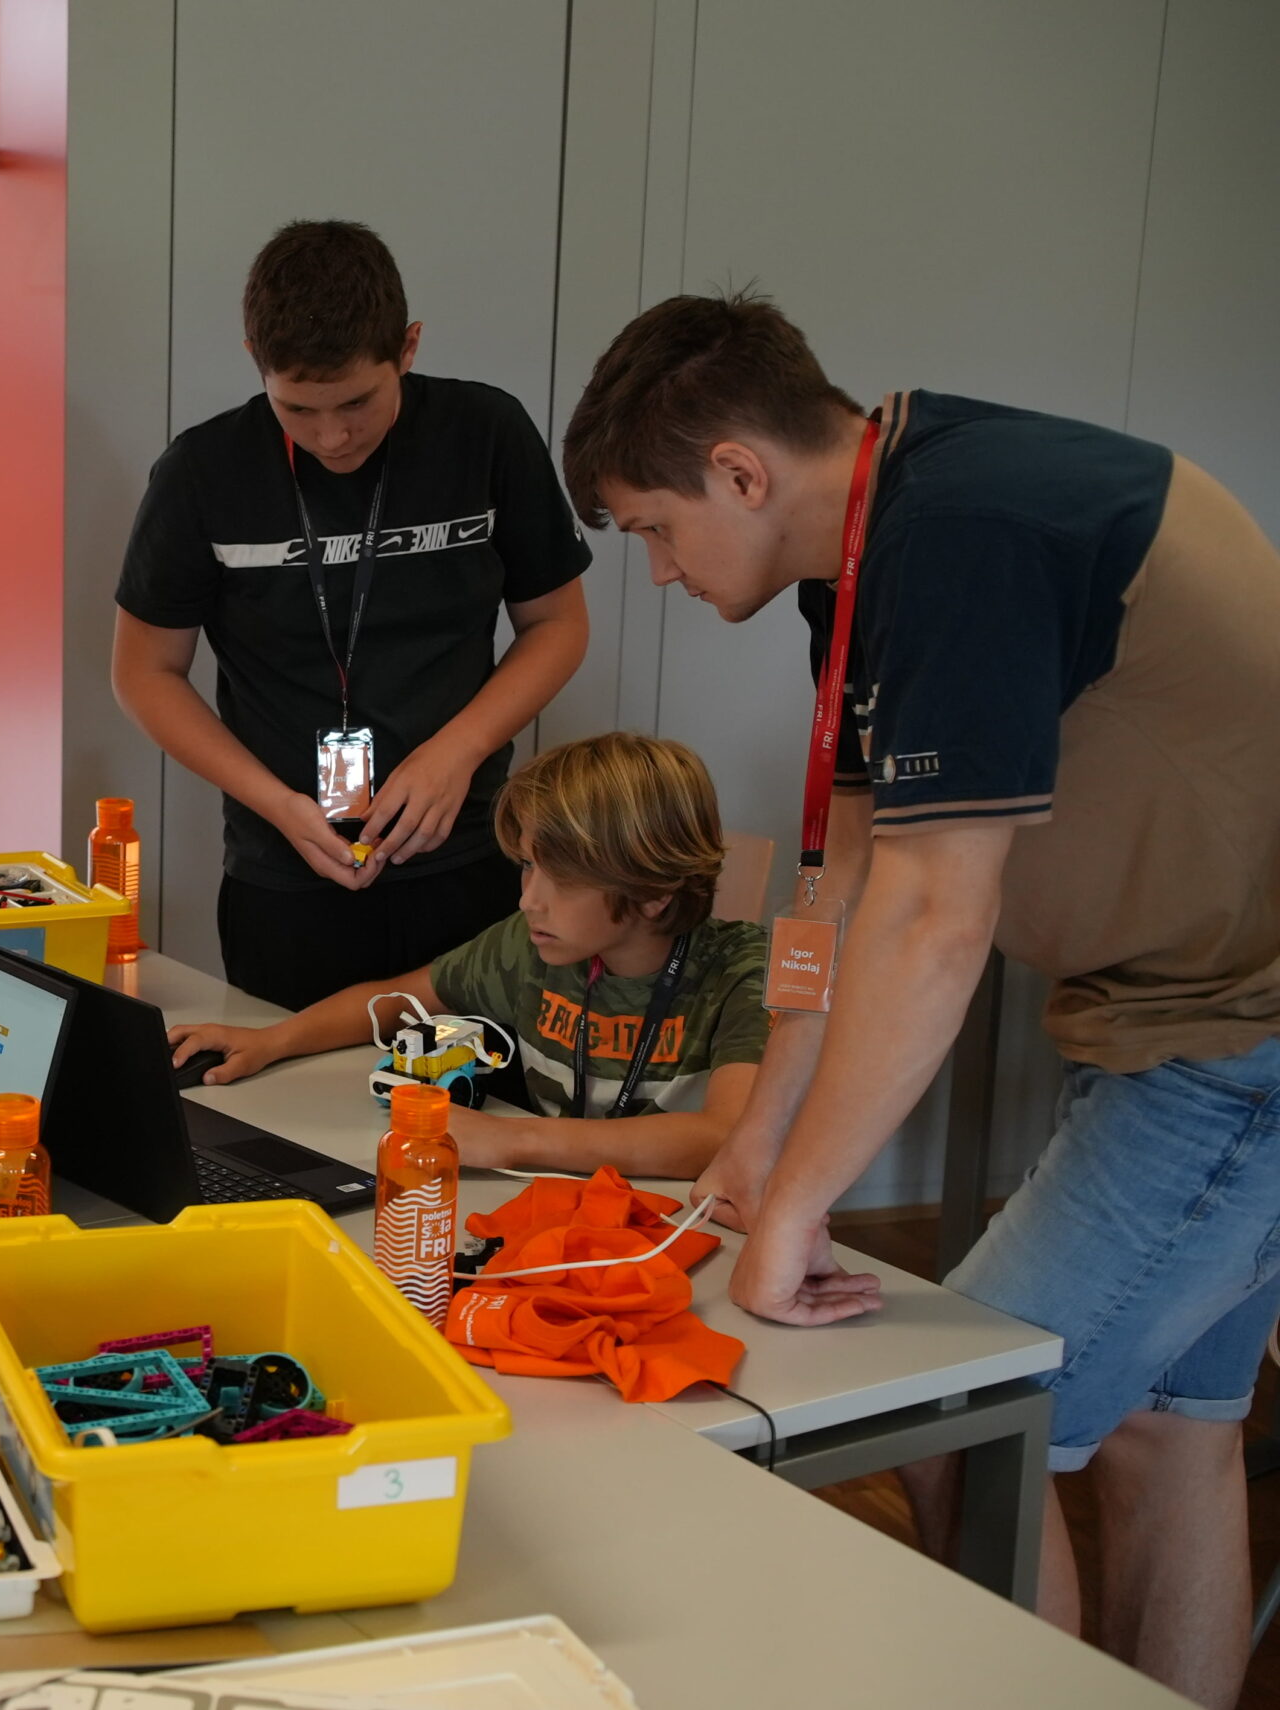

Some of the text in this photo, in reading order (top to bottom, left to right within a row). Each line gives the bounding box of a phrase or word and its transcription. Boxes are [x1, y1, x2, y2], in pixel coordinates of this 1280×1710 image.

[365, 531, 375, 546] FRI
[322, 534, 363, 564] NIKE
[846, 557, 856, 576] FRI
[822, 731, 834, 749] FRI
[791, 947, 814, 959] Igor
[668, 959, 680, 975] FRI
[781, 960, 820, 975] Nikolaj
[619, 1091, 629, 1108] FRI
[422, 1208, 452, 1223] poletna
[420, 1234, 451, 1258] FRI
[384, 1468, 404, 1499] 3
